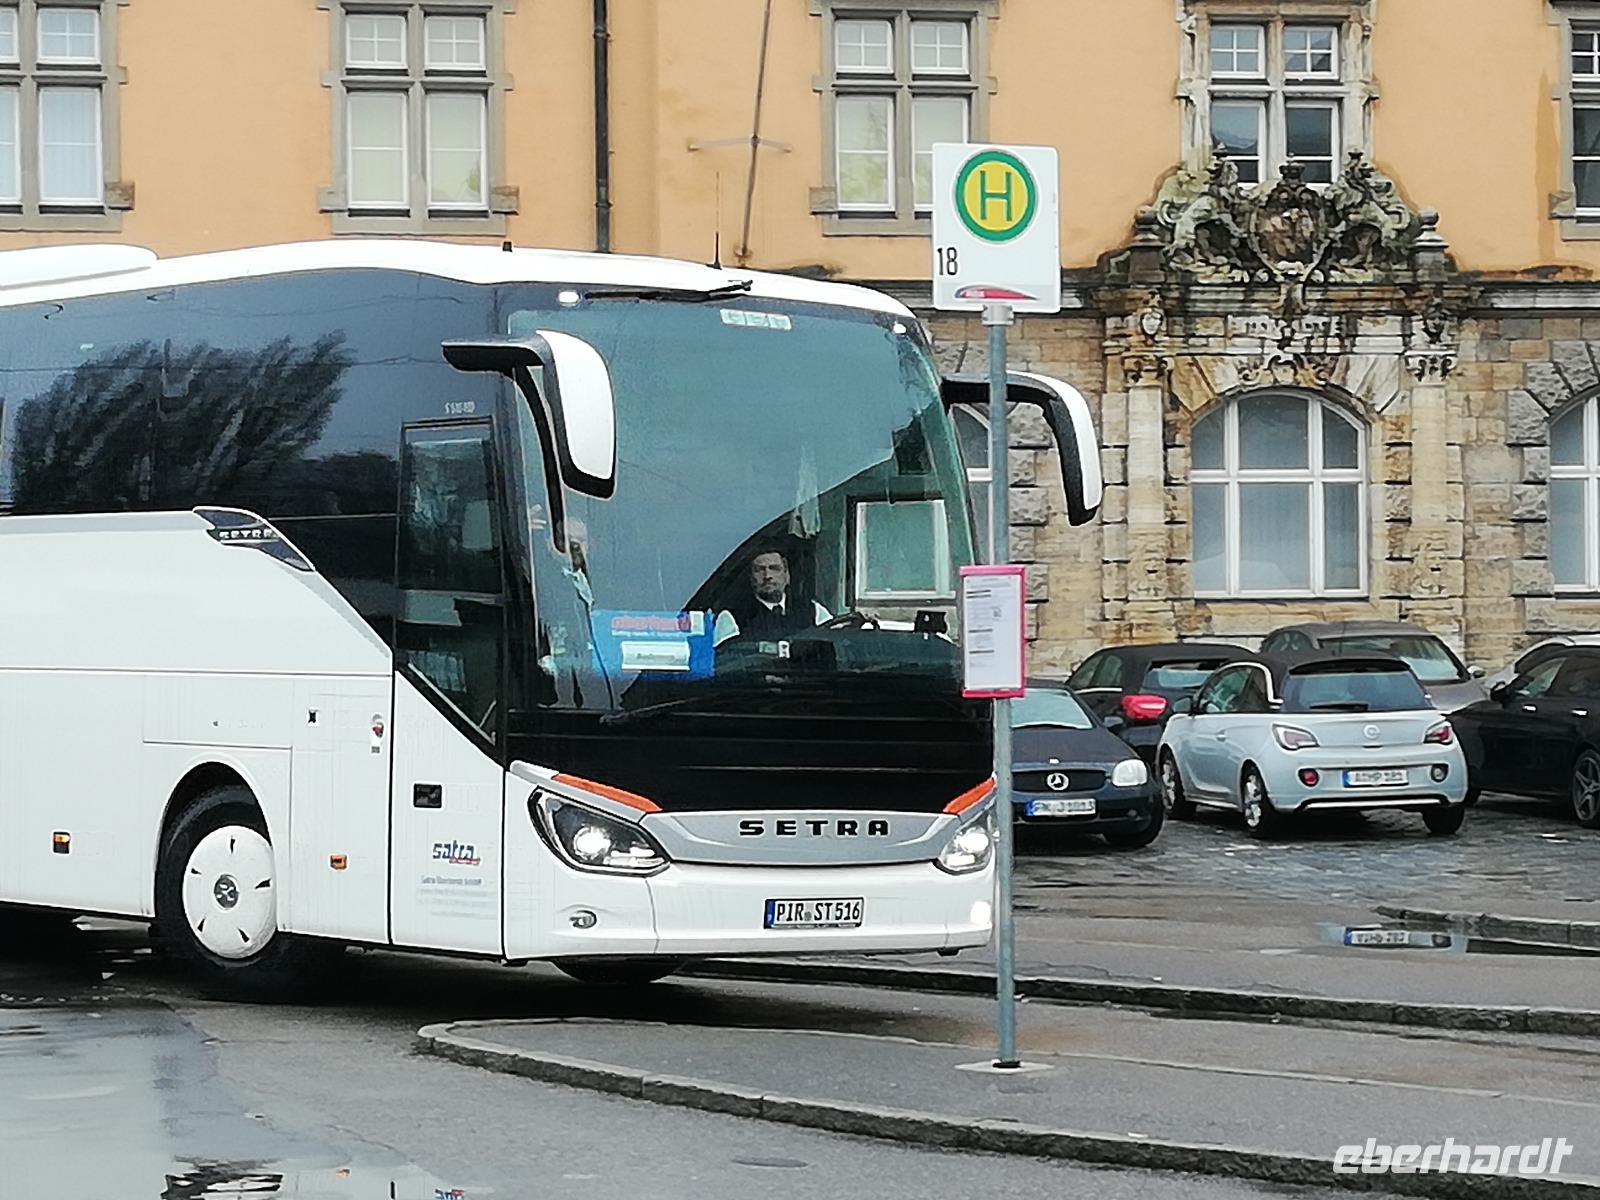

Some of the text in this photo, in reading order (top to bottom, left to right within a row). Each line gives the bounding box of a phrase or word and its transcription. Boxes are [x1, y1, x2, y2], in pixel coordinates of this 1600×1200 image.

[979, 170, 1012, 221] H
[937, 247, 958, 276] 18
[739, 820, 889, 836] SETRA
[777, 901, 860, 921] PIR ST 516
